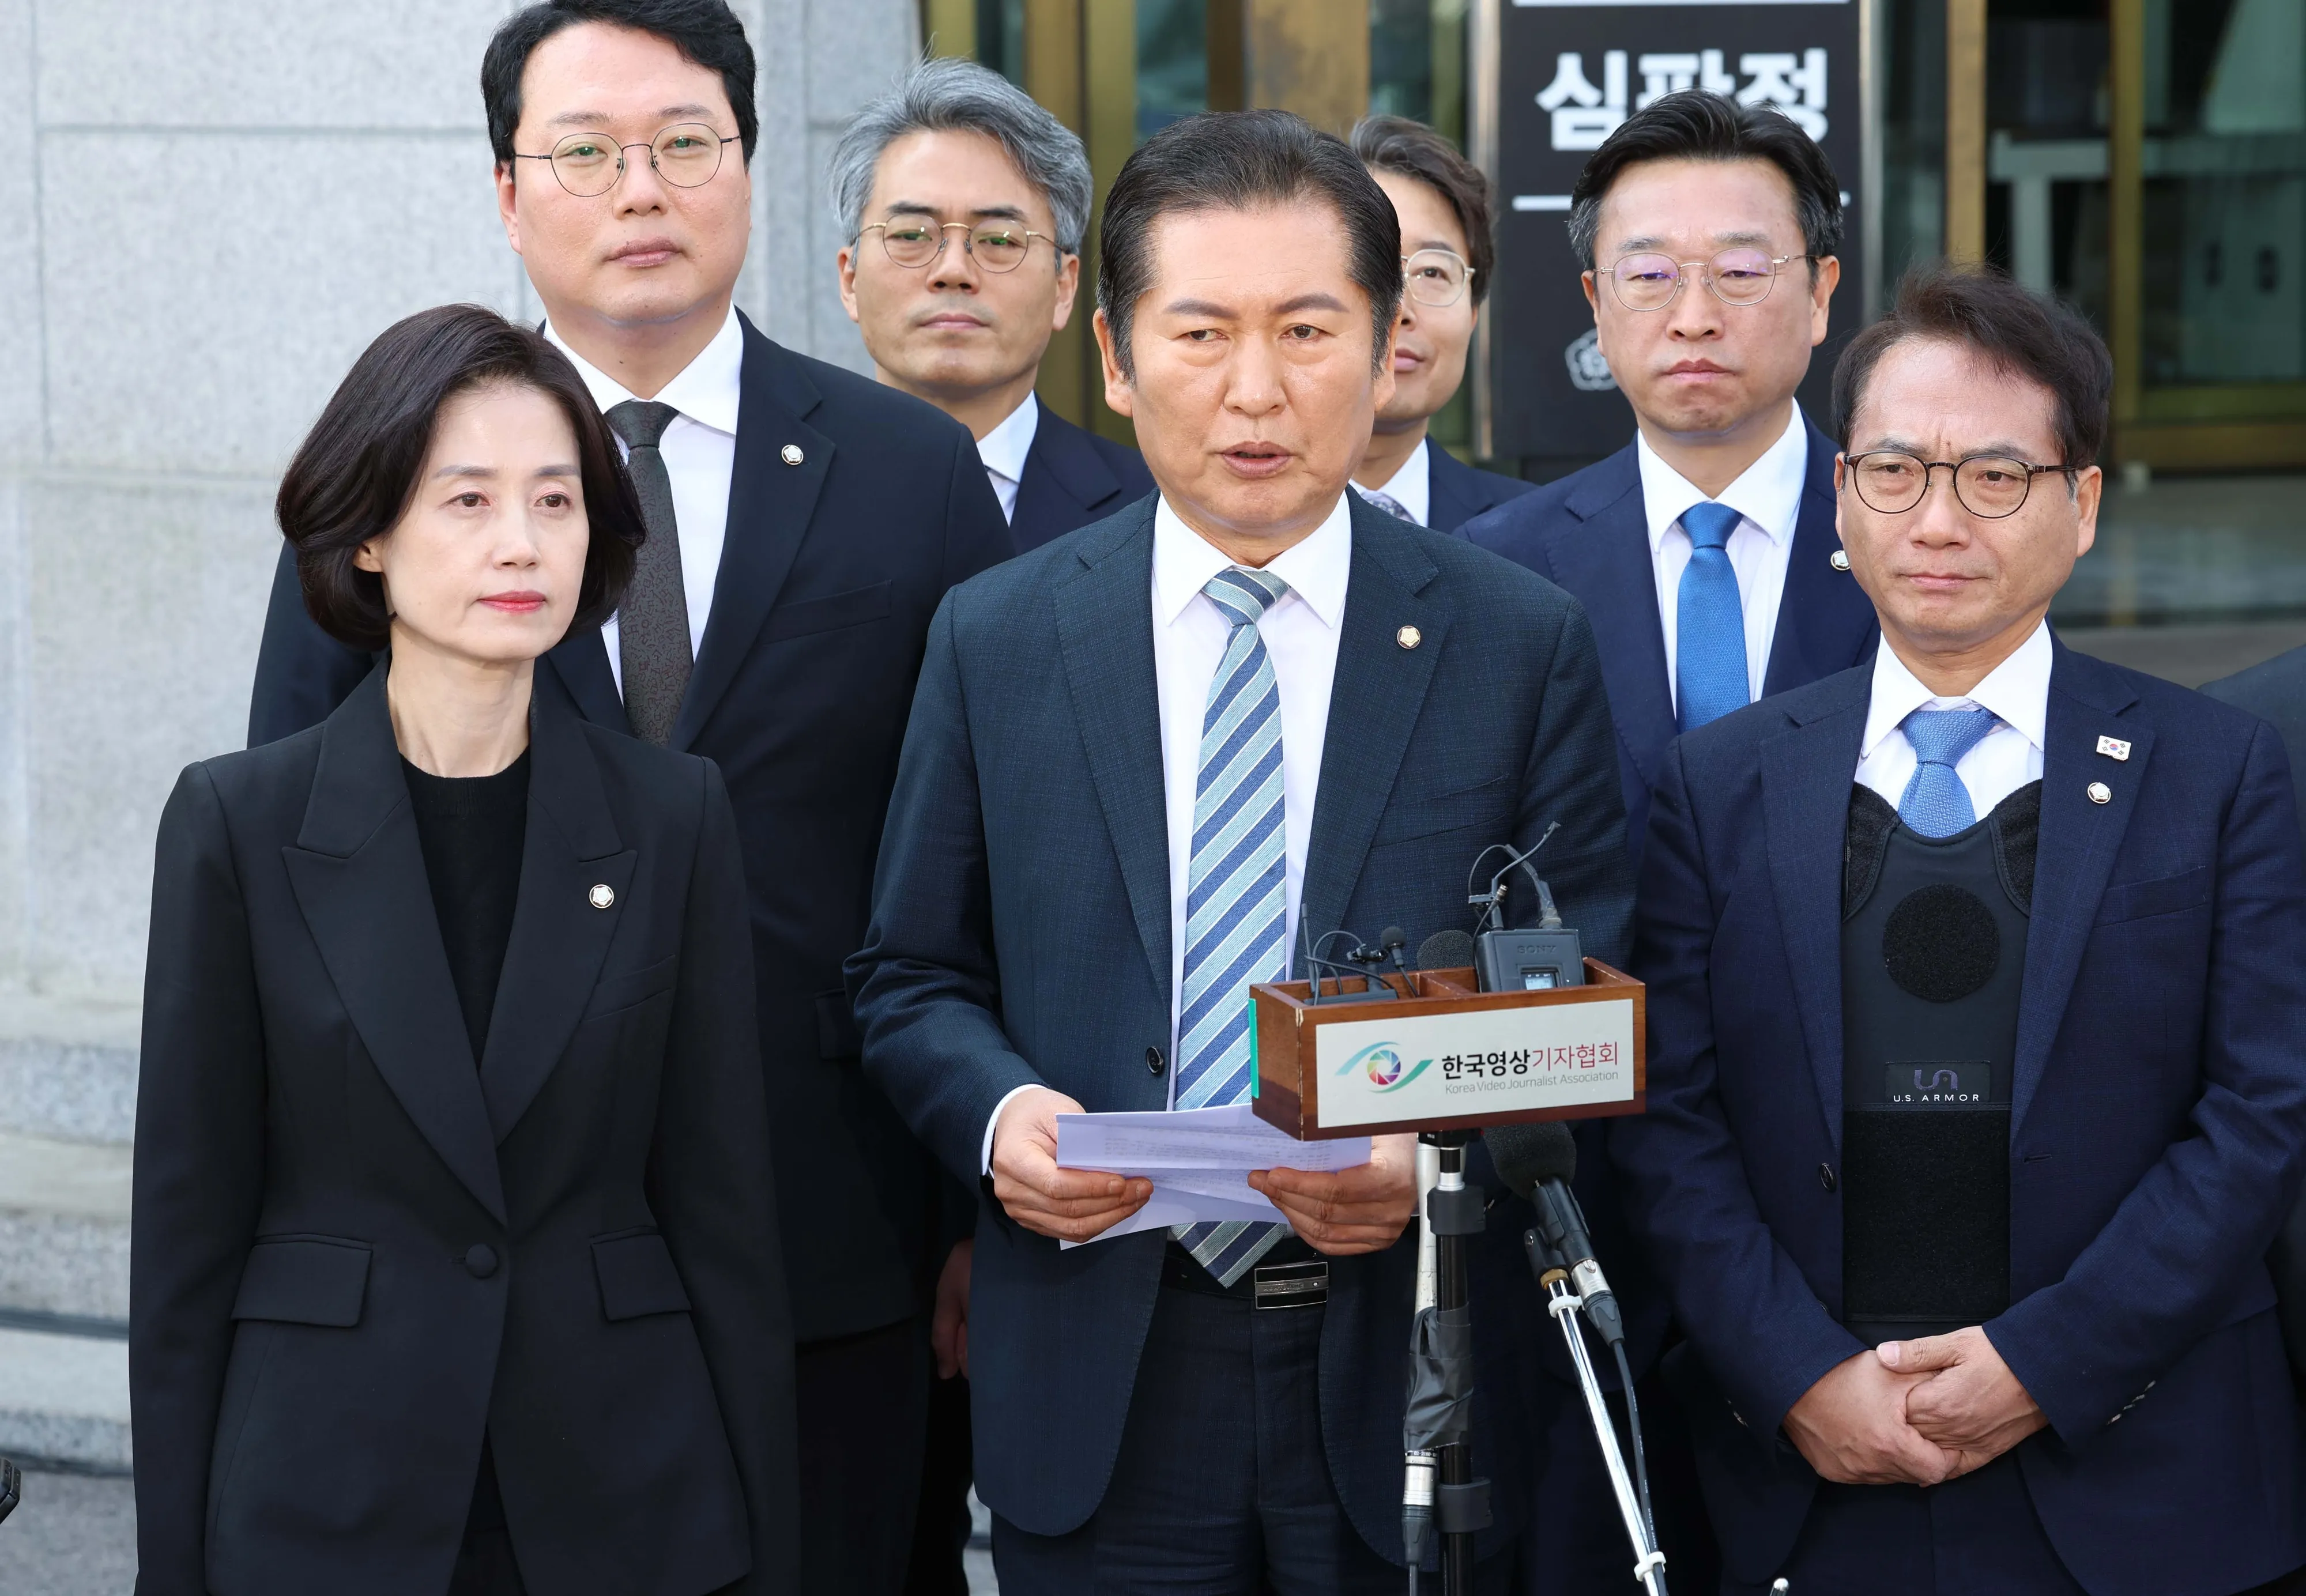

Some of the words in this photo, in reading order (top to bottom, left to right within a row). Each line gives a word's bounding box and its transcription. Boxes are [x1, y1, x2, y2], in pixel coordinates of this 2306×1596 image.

[1517, 945, 1557, 954] SONY
[1442, 1042, 1617, 1080] 한국영상기자협회
[1446, 1083, 1475, 1095] Korea
[1476, 1080, 1506, 1091] Video
[1507, 1076, 1557, 1089] Journalist
[1560, 1071, 1618, 1084] Association
[1921, 1094, 1979, 1102] ARMOR
